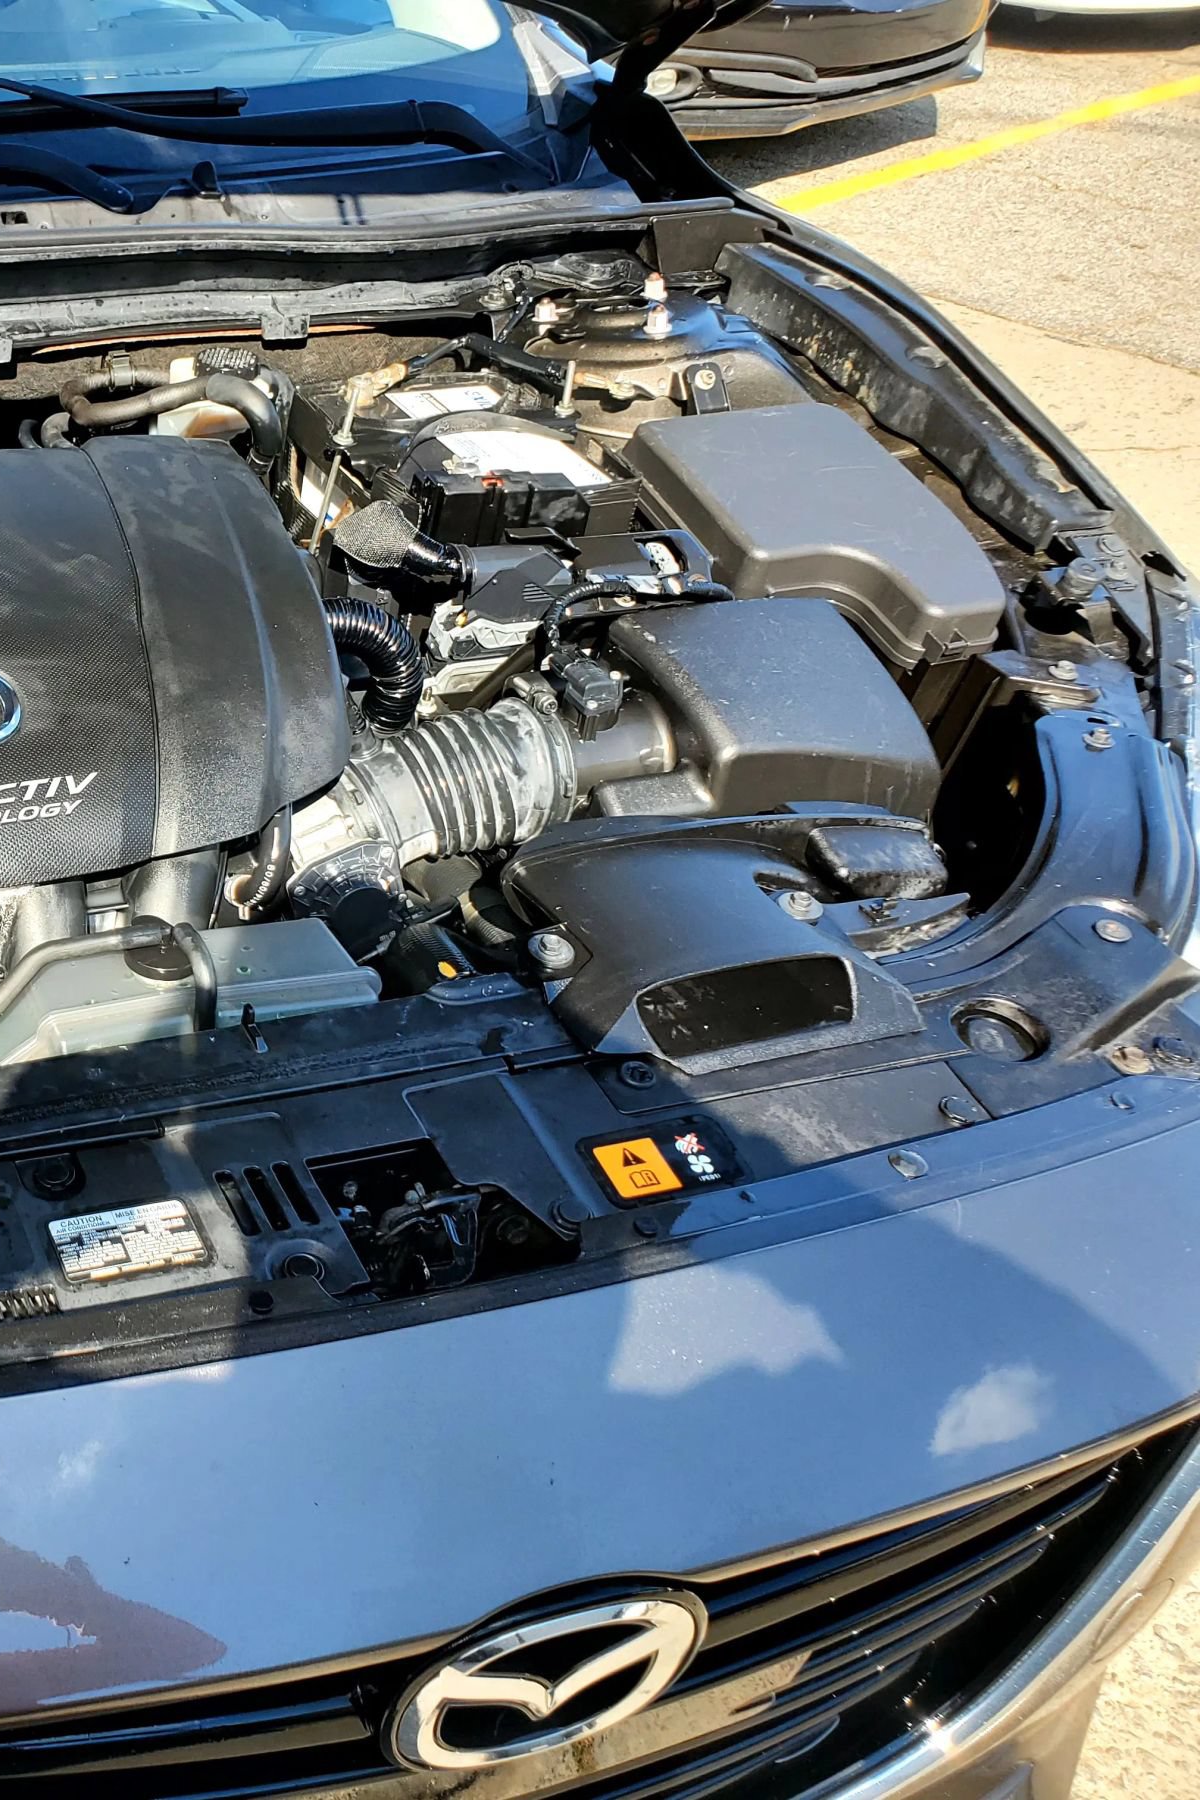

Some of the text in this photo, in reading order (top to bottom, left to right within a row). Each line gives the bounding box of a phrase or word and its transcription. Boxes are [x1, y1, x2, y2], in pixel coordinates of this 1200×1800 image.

[115, 1209, 134, 1218] MISE
[136, 1206, 149, 1214] EN
[60, 1215, 102, 1227] CAUTION
[67, 1219, 110, 1231] CONDITIONER
